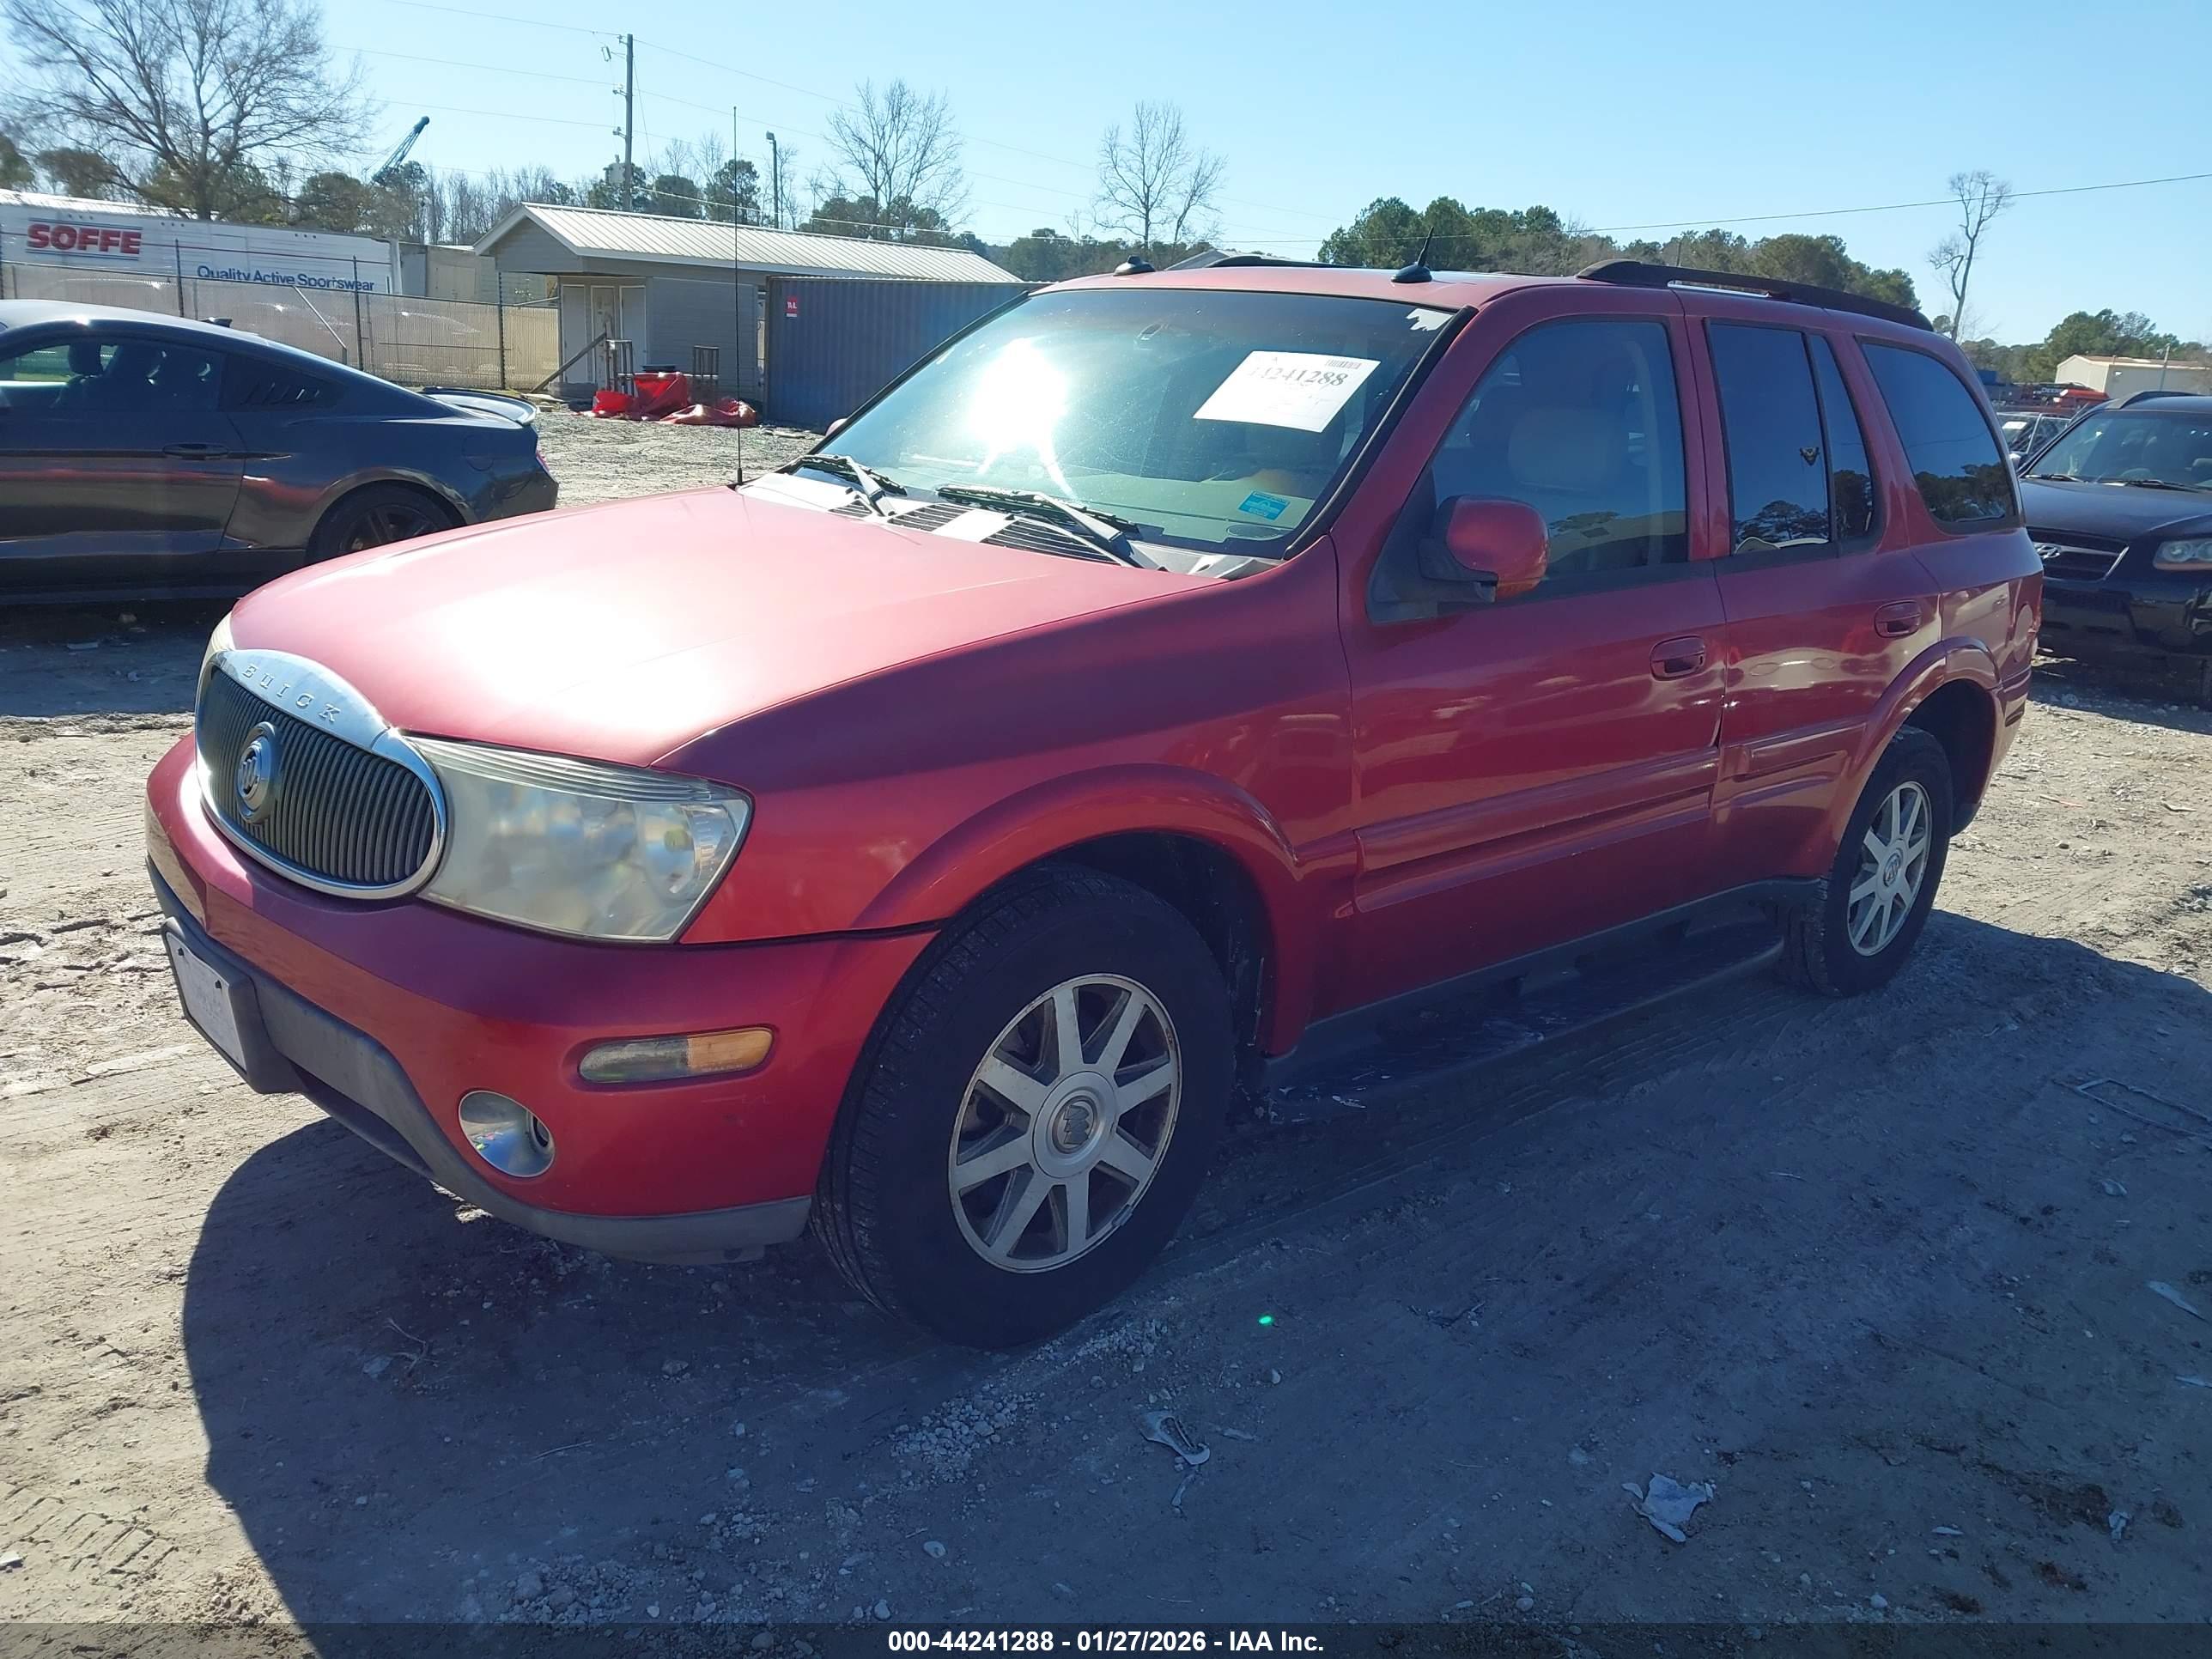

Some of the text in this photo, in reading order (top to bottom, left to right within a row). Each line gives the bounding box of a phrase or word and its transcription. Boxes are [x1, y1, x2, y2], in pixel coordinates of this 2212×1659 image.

[27, 223, 141, 254] SOFFE
[197, 264, 374, 292] Quality Active Sportswear
[241, 664, 342, 724] BUICK
